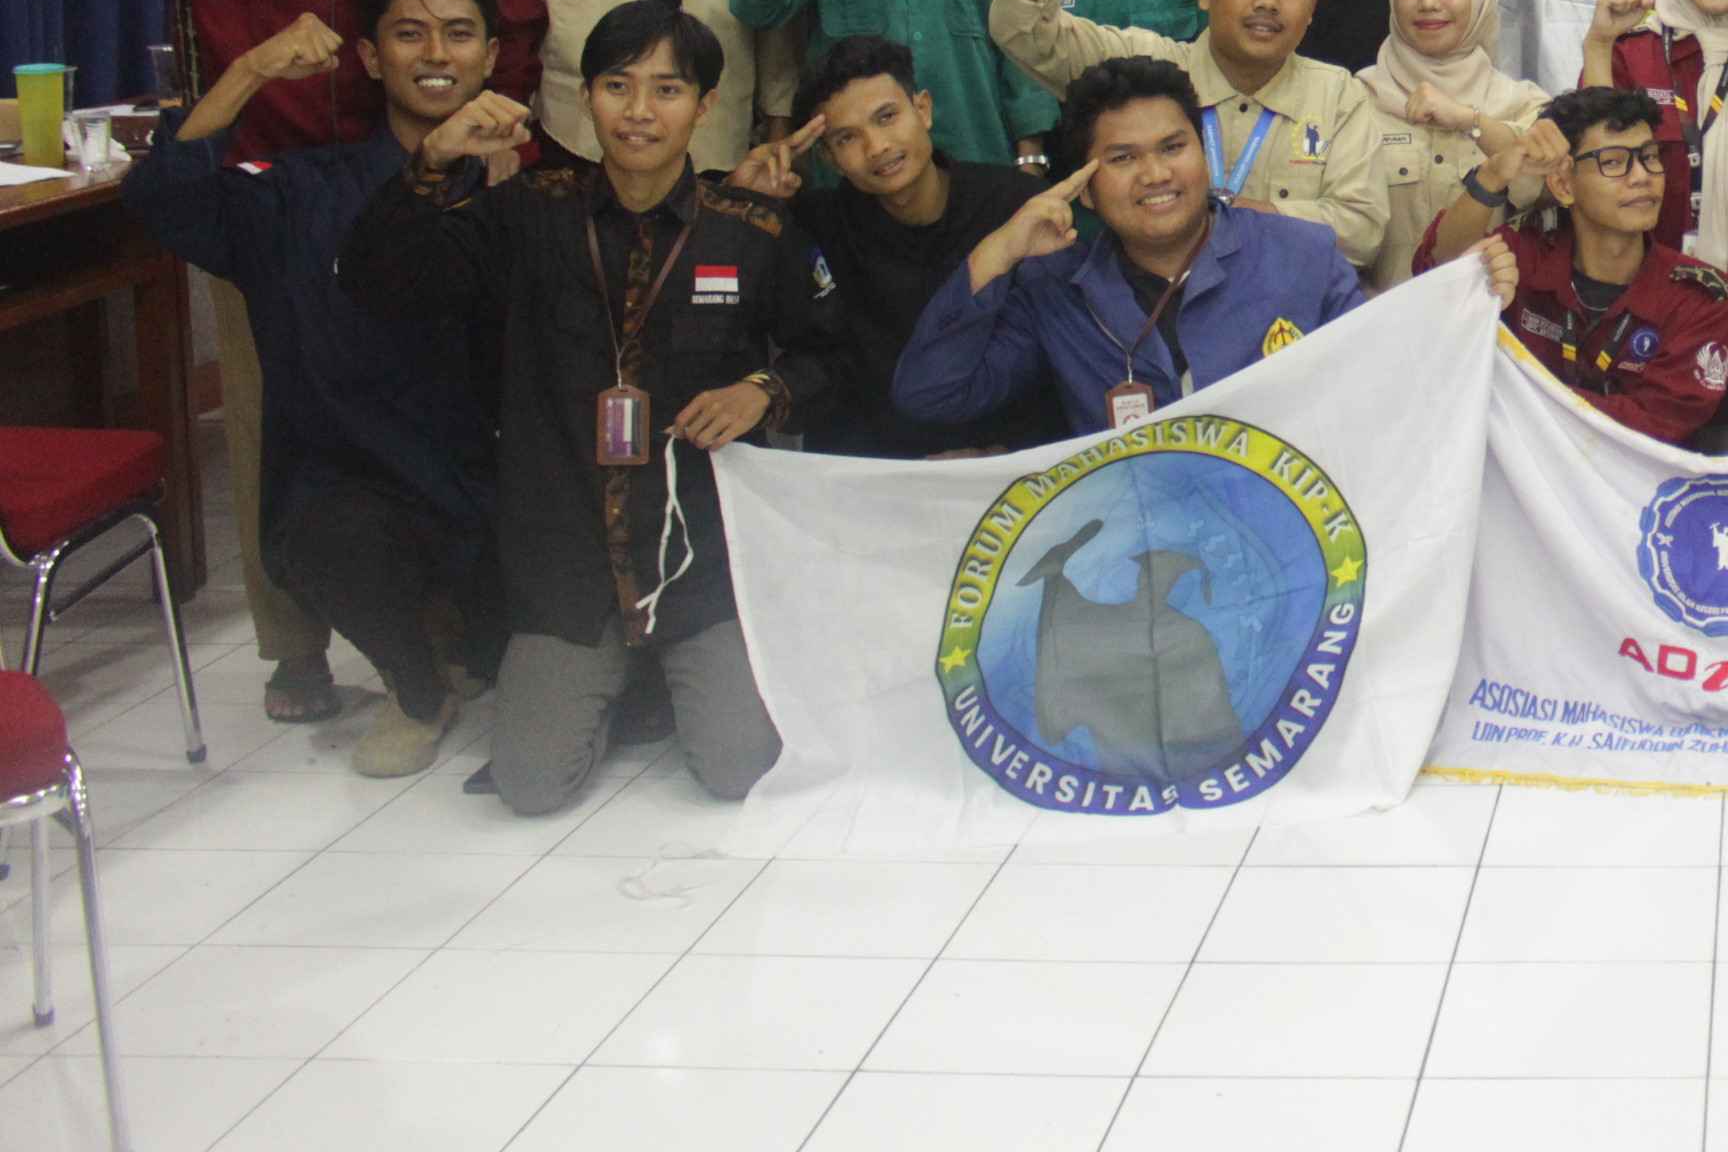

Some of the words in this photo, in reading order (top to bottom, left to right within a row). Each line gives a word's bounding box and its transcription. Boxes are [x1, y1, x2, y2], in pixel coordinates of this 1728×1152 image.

[950, 501, 1026, 629] FORUM
[1027, 420, 1250, 499] MAHASISWA
[954, 685, 1179, 812] UNIVERSITAS
[1199, 602, 1355, 802] SEMARANG
[1469, 678, 1557, 722] ASOSIASI
[1560, 699, 1666, 736] MAHASISWA
